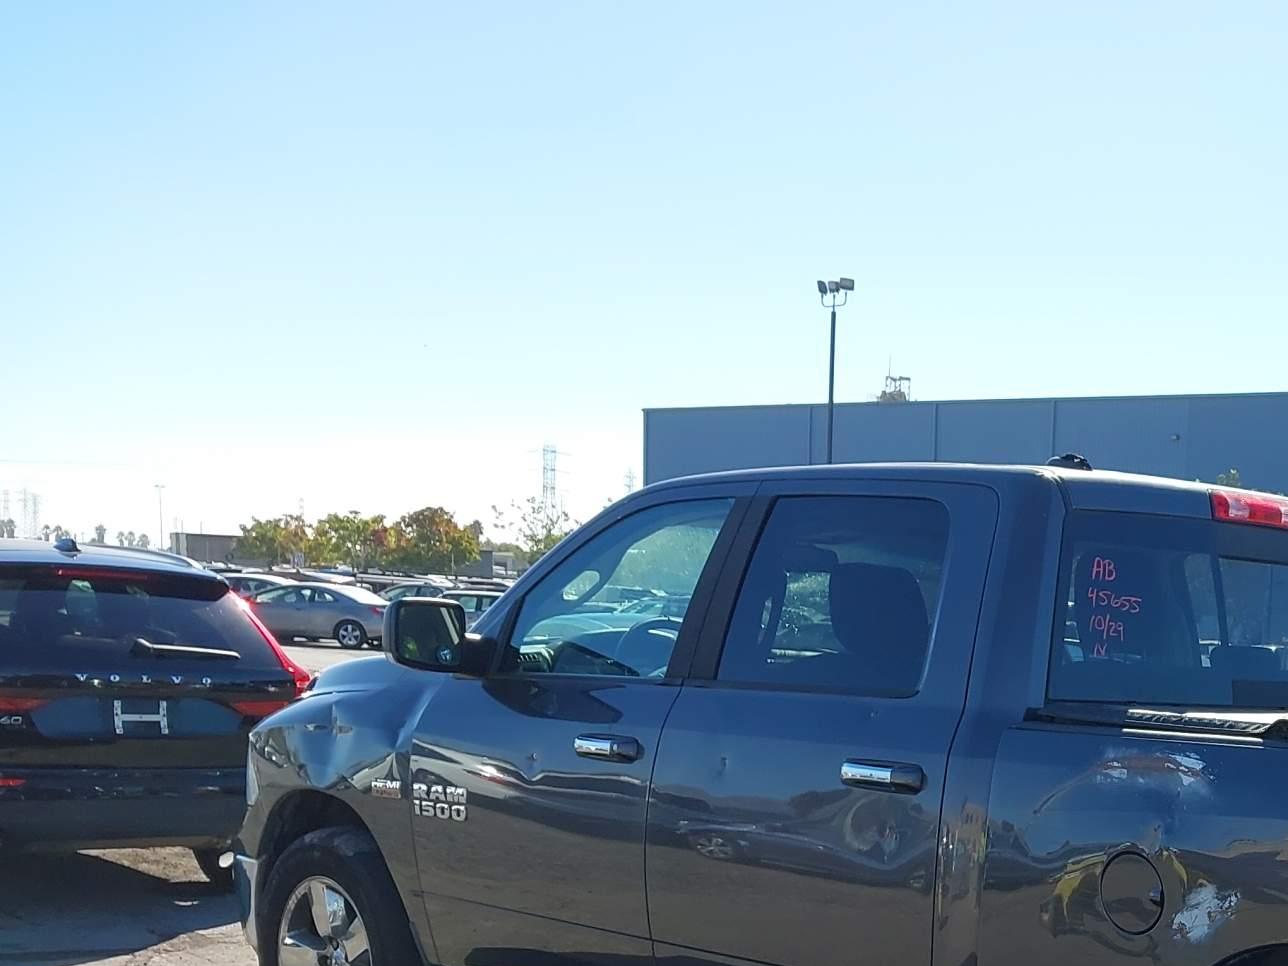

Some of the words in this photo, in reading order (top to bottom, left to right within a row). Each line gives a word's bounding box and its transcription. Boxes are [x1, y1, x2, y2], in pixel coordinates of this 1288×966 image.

[1091, 556, 1117, 582] AB
[1089, 614, 1125, 641] 10/29
[75, 673, 212, 685] VOLVO
[412, 783, 467, 804] RAM
[412, 800, 467, 822] 1500
